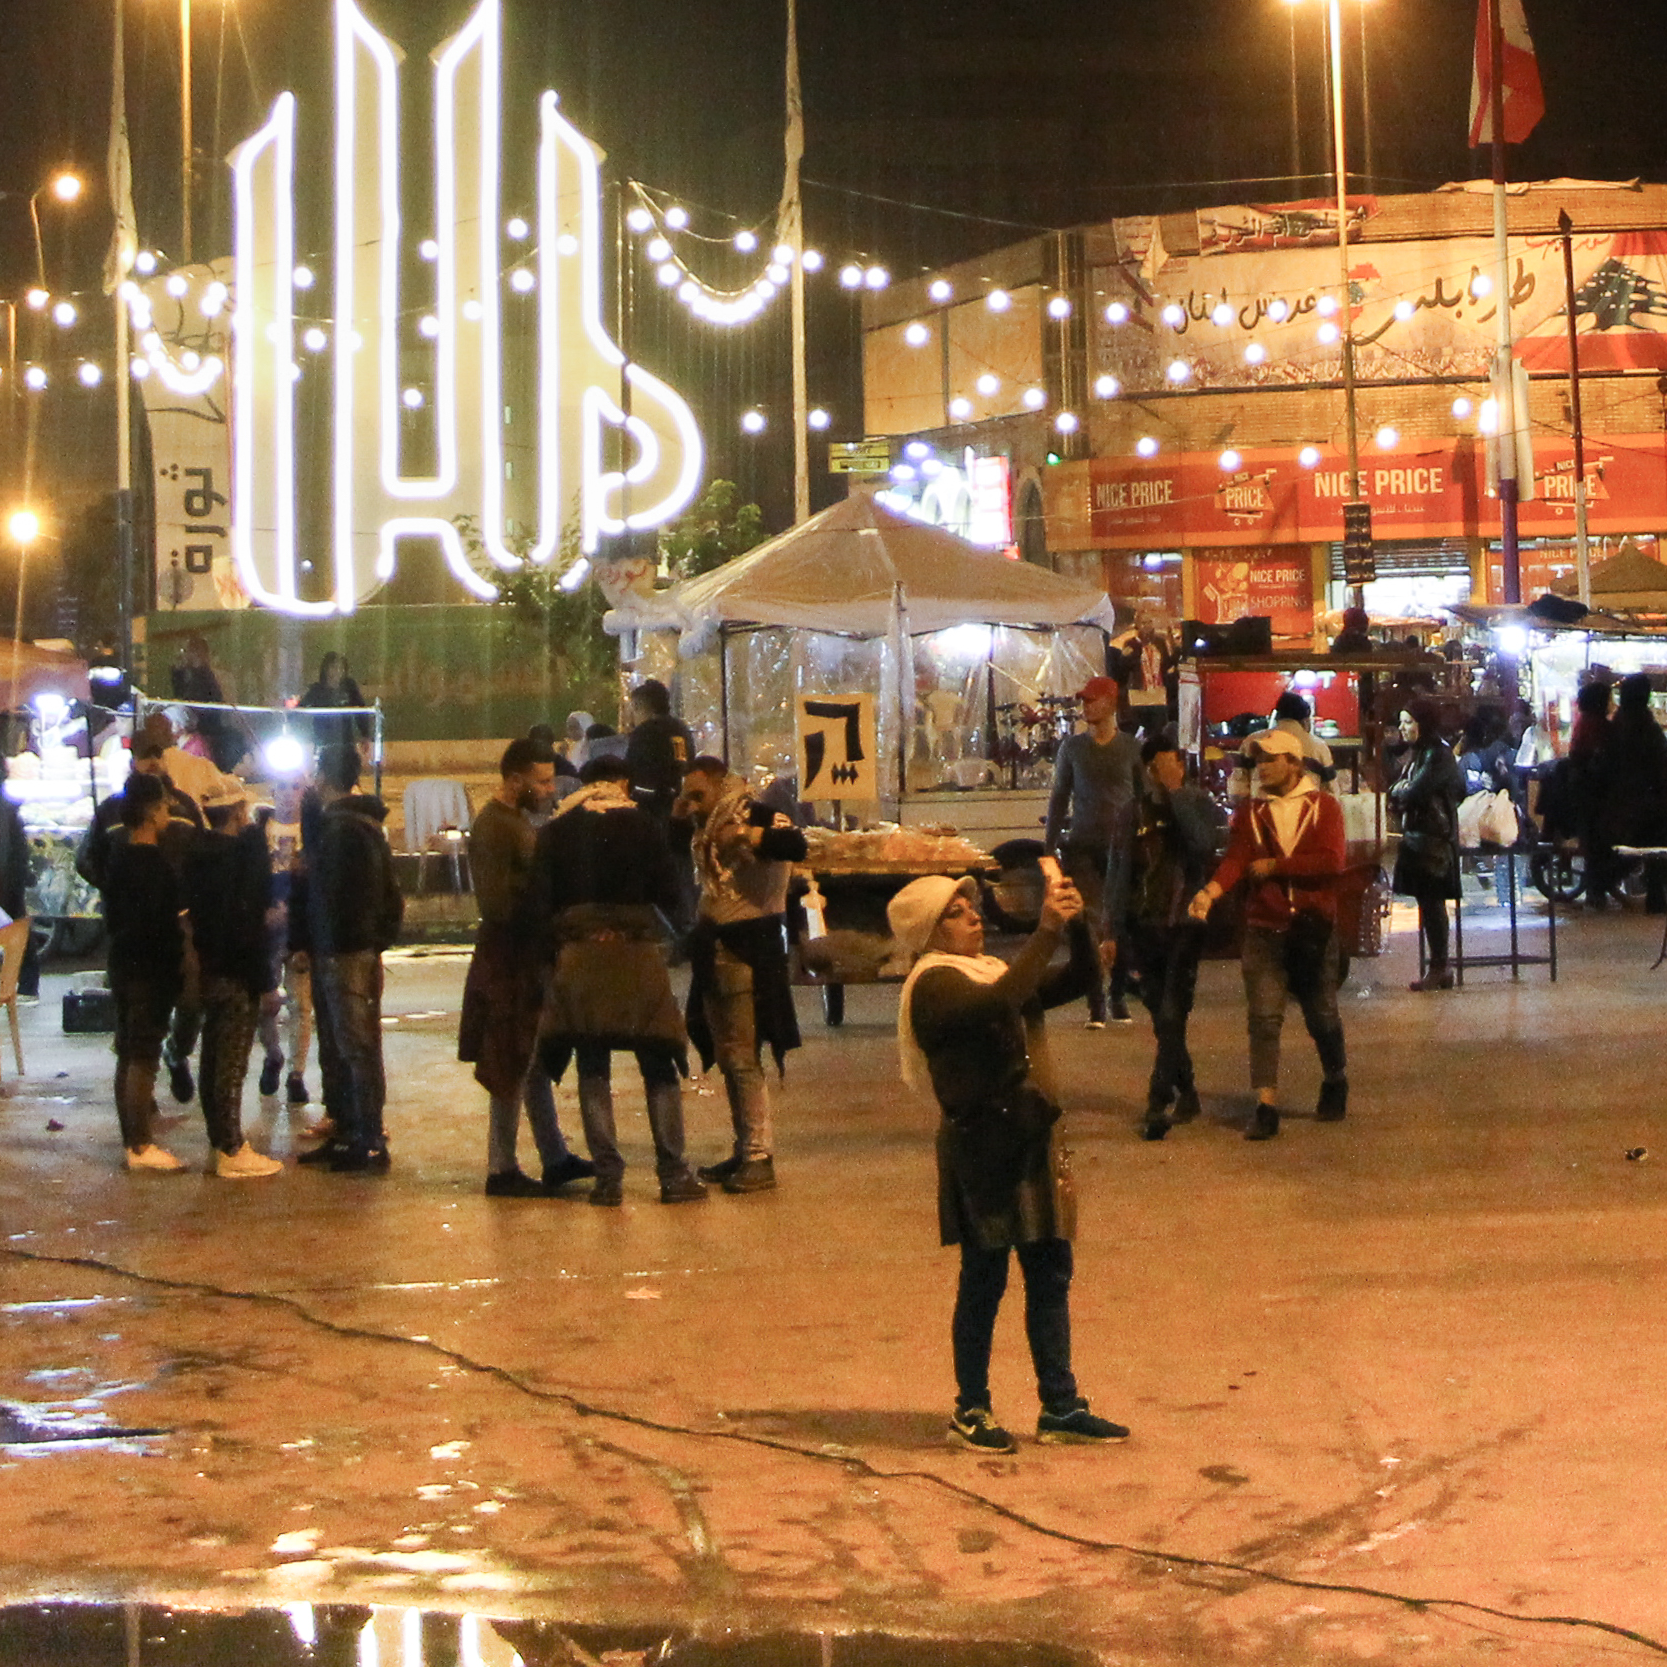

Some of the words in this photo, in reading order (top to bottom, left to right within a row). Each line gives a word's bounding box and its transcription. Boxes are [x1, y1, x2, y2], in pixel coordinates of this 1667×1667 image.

[1350, 257, 1536, 346] طرابلس
[1096, 482, 1128, 509] NICE
[1131, 479, 1174, 507] PRICE
[1314, 470, 1368, 498] NICE
[1375, 467, 1444, 495] PRICE
[1225, 487, 1266, 509] PRICE
[159, 462, 229, 573] ثورة
[1249, 569, 1274, 584] NICE
[1275, 568, 1306, 583] PRICE
[1250, 594, 1308, 612] SHOPPING
